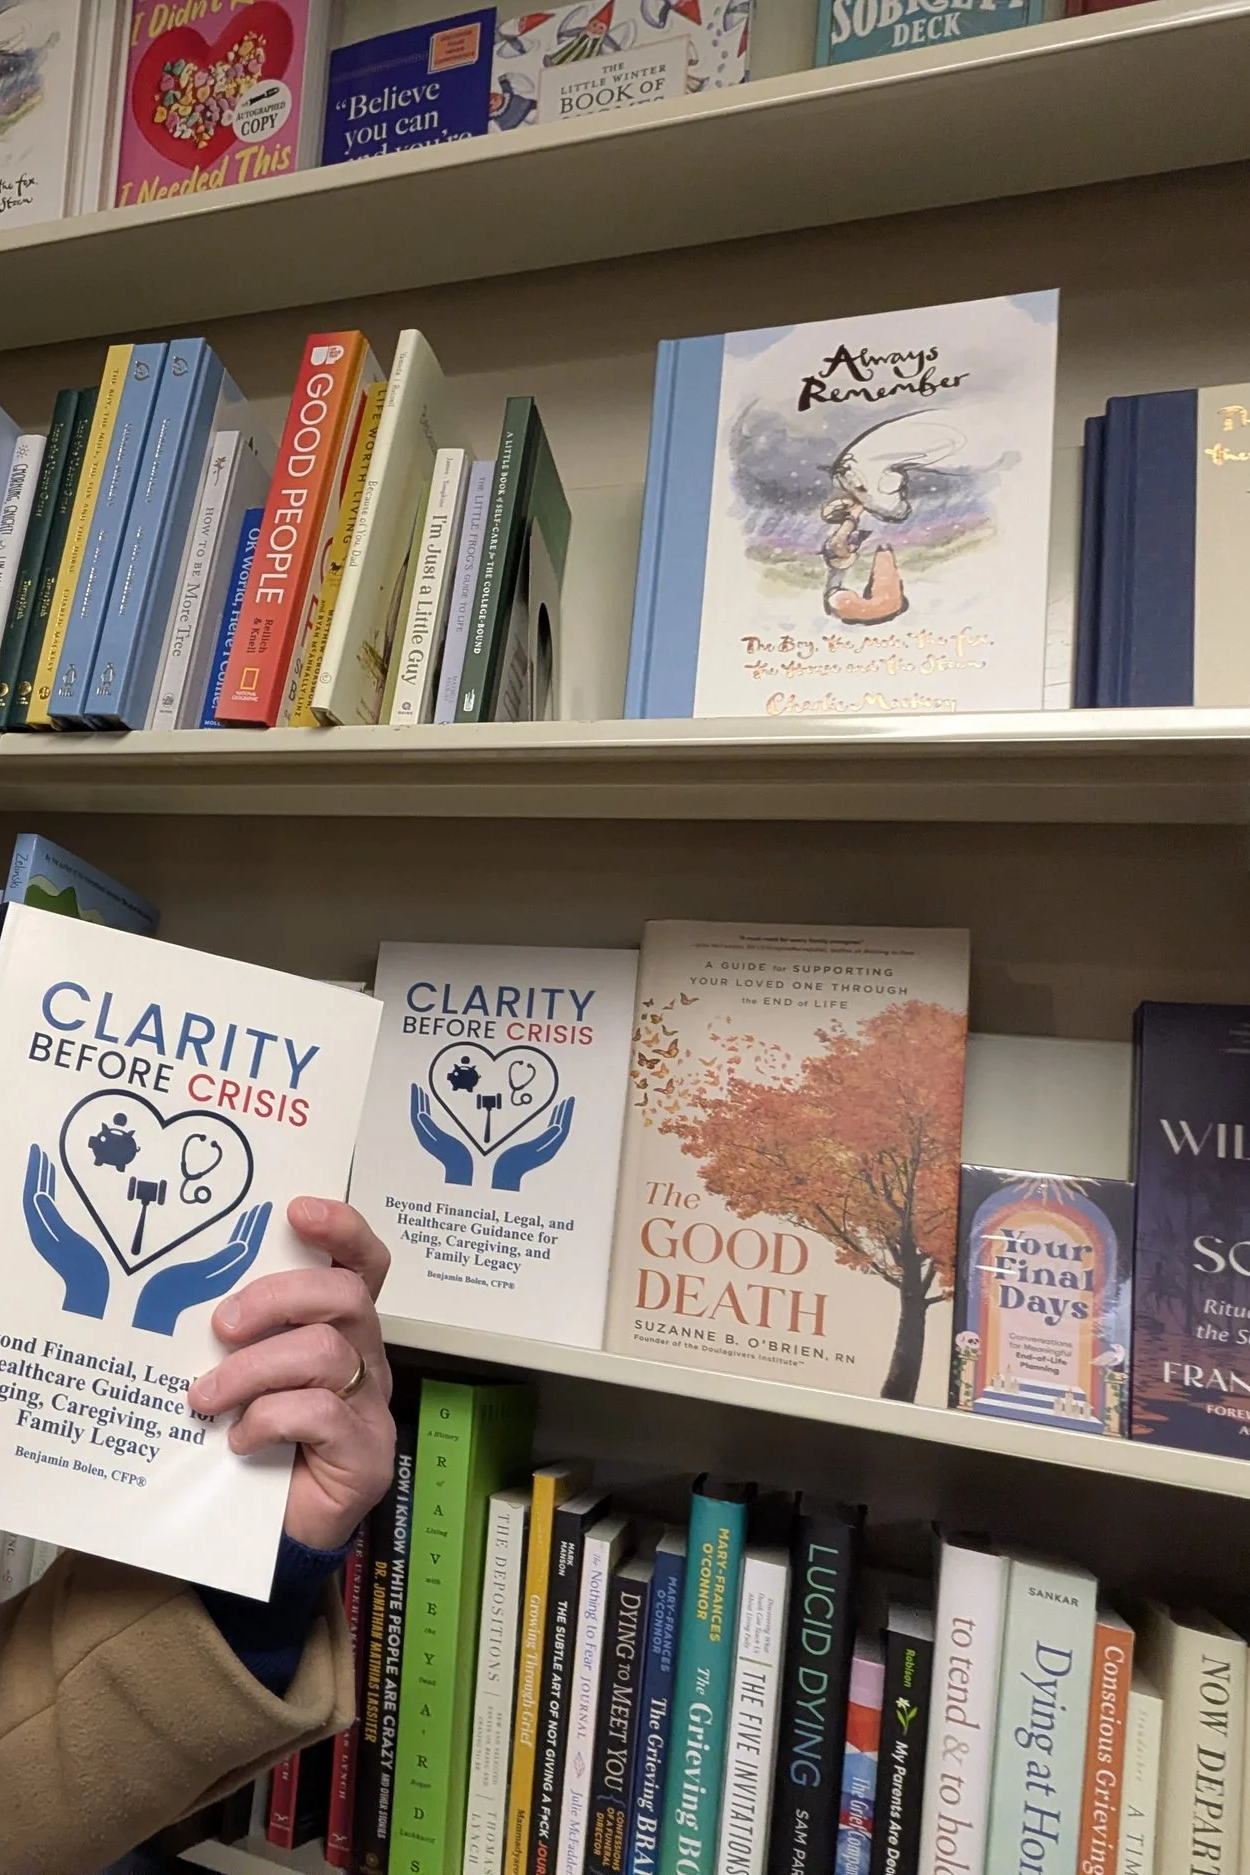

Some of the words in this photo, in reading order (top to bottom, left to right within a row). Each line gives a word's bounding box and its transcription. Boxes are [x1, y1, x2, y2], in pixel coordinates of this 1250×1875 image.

[892, 12, 961, 48] DECK
[561, 76, 606, 95] LITTLE
[613, 63, 667, 84] WINTER
[602, 61, 624, 74] THE
[236, 100, 286, 121] AUTOGRAPHED
[559, 86, 632, 114] BOOK
[641, 78, 666, 94] OF
[240, 112, 279, 136] COPY
[120, 182, 133, 206] I
[137, 162, 234, 203] Needed
[236, 144, 291, 186] This
[819, 343, 940, 381] Always
[797, 368, 970, 412] Remember
[287, 374, 334, 478] GOOD
[202, 507, 214, 536] HOW
[430, 514, 448, 540] I'm
[197, 541, 206, 558] TO
[255, 489, 308, 604] PEOPLE
[423, 544, 442, 580] Just
[192, 562, 202, 577] BE
[179, 582, 198, 623] More
[419, 585, 432, 594] a
[173, 624, 192, 657] Tree
[412, 601, 435, 644] Little
[402, 648, 424, 686] Guy
[10, 853, 29, 888] Zelinski
[690, 977, 728, 987] YOUR
[735, 979, 784, 989] LOVED
[792, 981, 823, 991] ONE
[832, 984, 908, 995] THROUGH
[721, 962, 766, 972] GUIDE
[792, 964, 894, 977] SUPPORTING
[406, 982, 596, 1021] CLARITY
[742, 996, 758, 1004] the
[763, 997, 792, 1006] END
[814, 1000, 848, 1009] LIFE
[42, 981, 320, 1090] CLARITY
[403, 1016, 497, 1039] BEFORE
[507, 1022, 594, 1045] CRISIS
[28, 1032, 174, 1093] BEFORE
[188, 1073, 309, 1127] CRISIS
[385, 1196, 432, 1212] Beyond
[436, 1203, 500, 1223] Financial,
[504, 1212, 545, 1229] Legal,
[549, 1220, 575, 1231] and
[646, 1181, 701, 1210] The
[397, 1213, 467, 1233] Healthcare
[470, 1223, 534, 1241] Guidance
[538, 1232, 558, 1245] for
[400, 1230, 442, 1246] Aging,
[446, 1235, 521, 1258] Caregiving,
[526, 1249, 551, 1259] and
[641, 1217, 808, 1275] GOOD
[1000, 1229, 1093, 1262] Your
[425, 1248, 470, 1266] Family
[474, 1254, 521, 1273] Legacy
[995, 1256, 1093, 1292] Final
[636, 1269, 828, 1337] DEATH
[1000, 1285, 1088, 1326] Days
[635, 1320, 716, 1341] SUZANNE
[726, 1335, 739, 1345] B.
[749, 1338, 829, 1361] O'BRIEN,
[836, 1353, 855, 1364] RN
[1009, 1333, 1072, 1349] Conversations
[1015, 1352, 1067, 1366] End-of-Life
[1027, 1344, 1072, 1358] Meaningful
[44, 1340, 137, 1382] Financial,
[1020, 1362, 1059, 1375] Planning
[92, 1378, 184, 1415] Guidance
[16, 1409, 85, 1444] Family
[90, 1426, 160, 1462] Legacy
[52, 1393, 162, 1438] Caregiving,
[169, 1427, 206, 1446] and
[15, 1446, 70, 1468] Benjamin
[73, 1460, 108, 1479] Bolen,
[111, 1470, 146, 1487] CFP®
[397, 1454, 412, 1492] HOW
[391, 1503, 408, 1555] KNOW
[495, 1513, 509, 1549] THE
[558, 1540, 566, 1577] MANSON
[566, 1542, 575, 1567] MARK
[592, 1553, 601, 1568] The
[390, 1559, 405, 1611] WHITE
[582, 1570, 601, 1622] Nothing
[696, 1543, 714, 1621] O'CONNOR
[708, 1527, 730, 1643] MARY-FRANCES
[800, 1543, 839, 1657] LUCID
[1029, 1587, 1079, 1607] SANKAR
[487, 1556, 507, 1685] DEPOSITIONS
[587, 1625, 594, 1641] to
[614, 1591, 640, 1659] DYING
[950, 1617, 976, 1648] to
[385, 1614, 404, 1679] PEOPLE
[582, 1642, 597, 1672] Fear
[616, 1663, 631, 1680] TO
[696, 1667, 711, 1695] The
[903, 1648, 916, 1688] Robison
[382, 1681, 400, 1711] ARE
[576, 1676, 591, 1740] JOURNAL
[944, 1657, 980, 1731] tend
[1014, 1640, 1073, 1758] Dying
[1096, 1645, 1125, 1765] Conscious
[1198, 1654, 1231, 1736] NOW
[607, 1686, 633, 1744] MEET
[789, 1670, 828, 1788] DYING
[379, 1715, 399, 1769] CRAZY
[943, 1734, 970, 1767] &
[604, 1745, 628, 1793] YOU
[675, 1702, 715, 1831] Grieving
[1026, 1761, 1057, 1797] at
[939, 1775, 968, 1806] to
